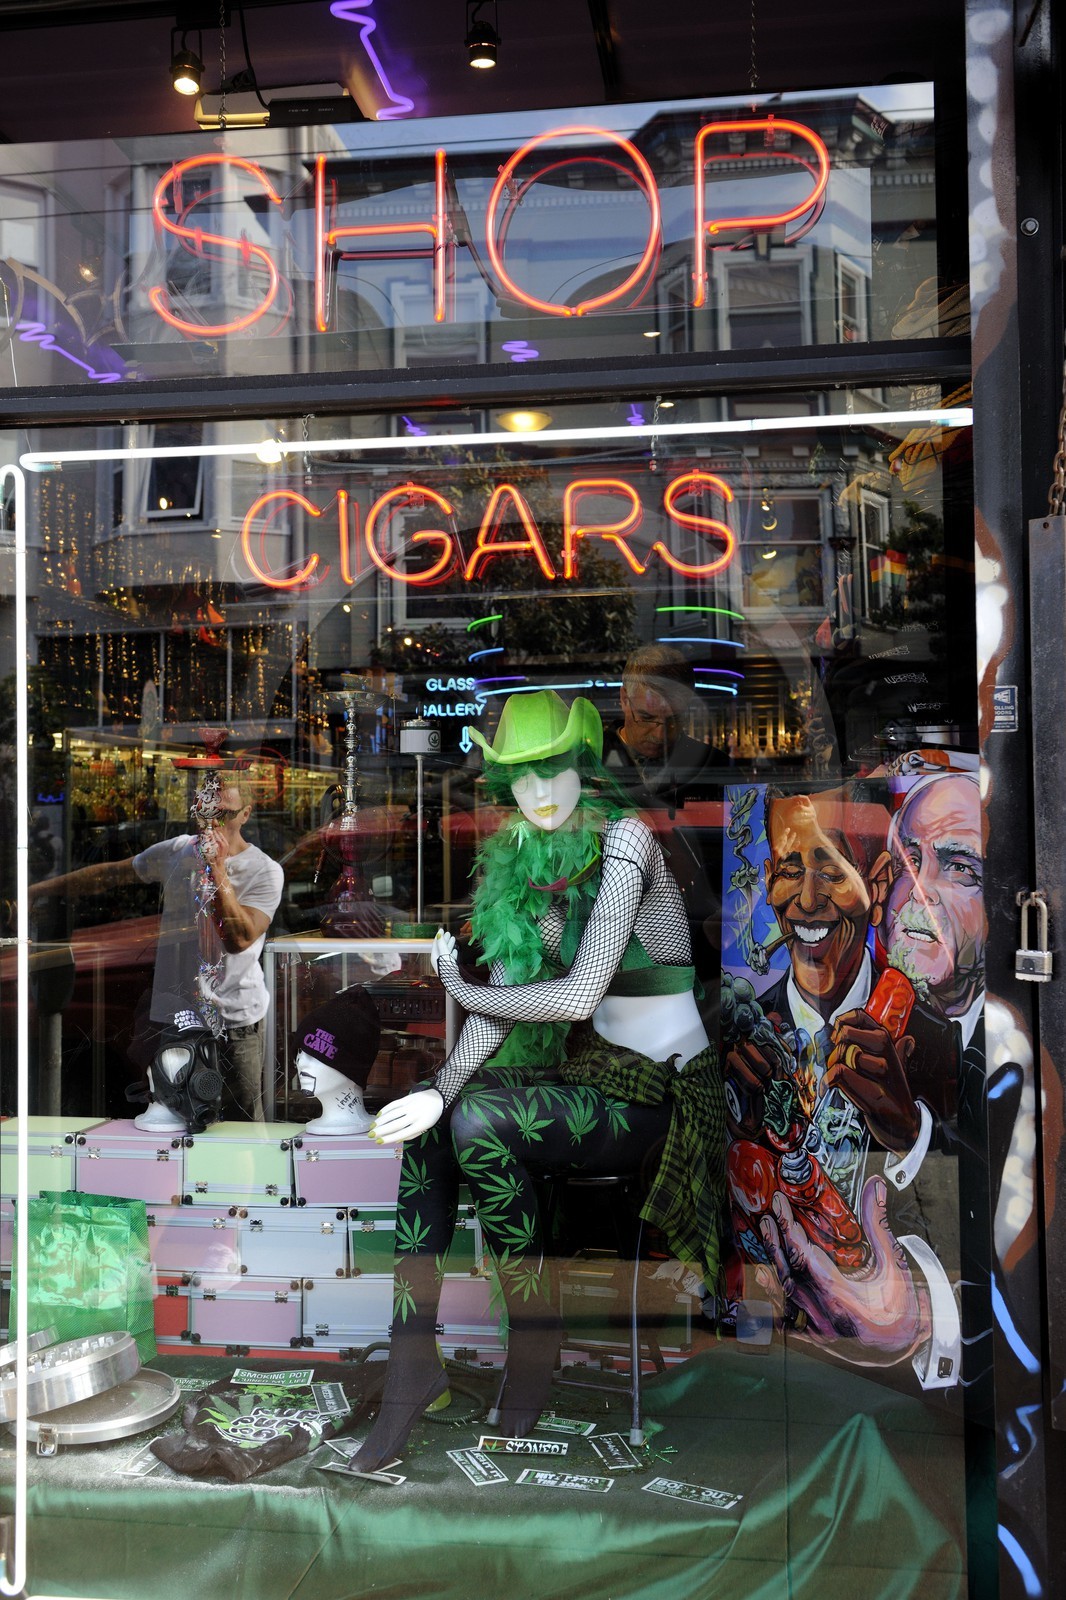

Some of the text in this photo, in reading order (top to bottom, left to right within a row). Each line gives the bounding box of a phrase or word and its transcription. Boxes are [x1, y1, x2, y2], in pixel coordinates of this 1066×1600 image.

[149, 119, 830, 336] SHOP
[240, 472, 738, 588] CIGARS
[426, 677, 476, 691] GLASS
[303, 1033, 339, 1060] CAVE
[315, 1028, 336, 1044] THE
[240, 1371, 309, 1380] SMOKING POT
